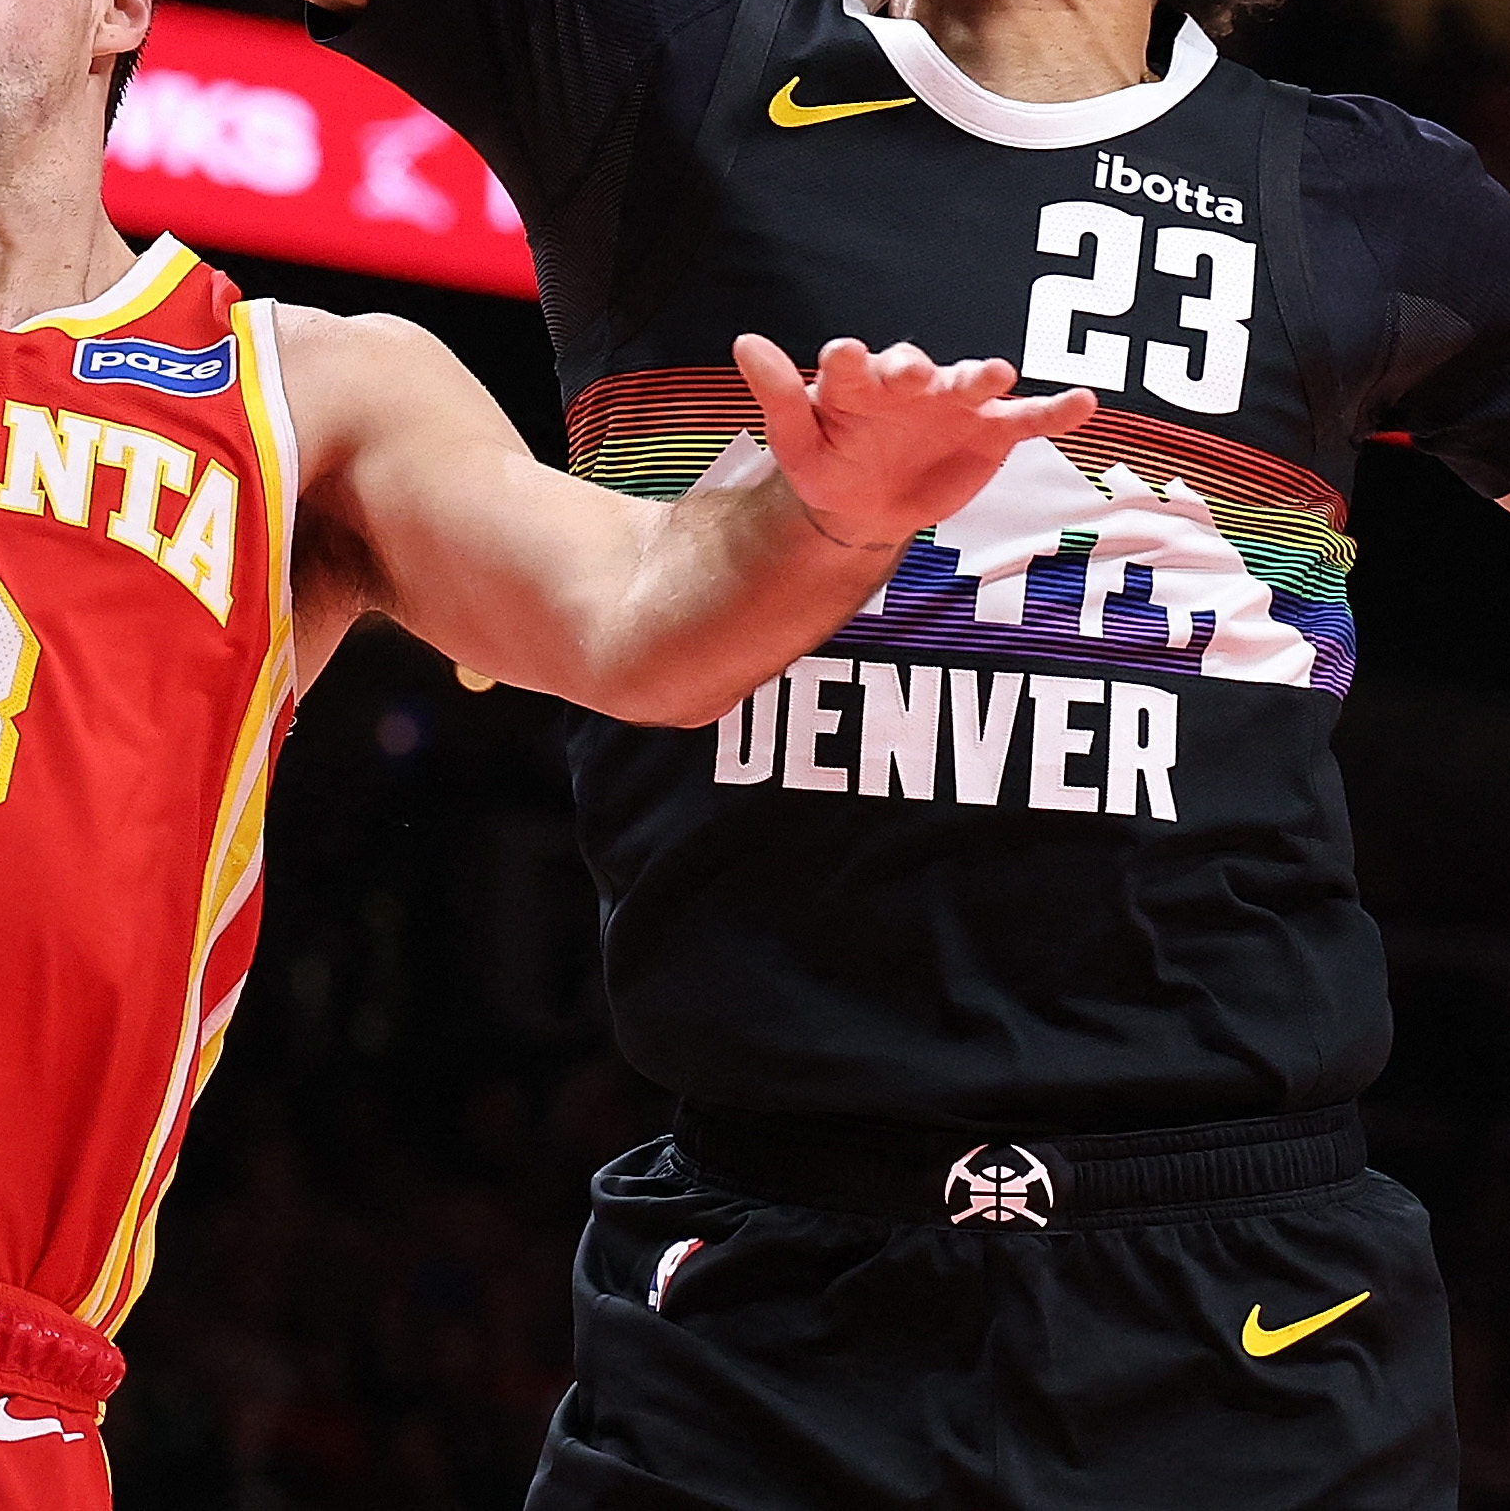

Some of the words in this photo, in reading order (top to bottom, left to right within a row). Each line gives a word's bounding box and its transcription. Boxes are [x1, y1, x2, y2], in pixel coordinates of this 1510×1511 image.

[1095, 150, 1244, 225] ibotta
[90, 344, 222, 382] paze
[1020, 200, 1258, 416] 23
[713, 655, 1179, 823] DENVER
